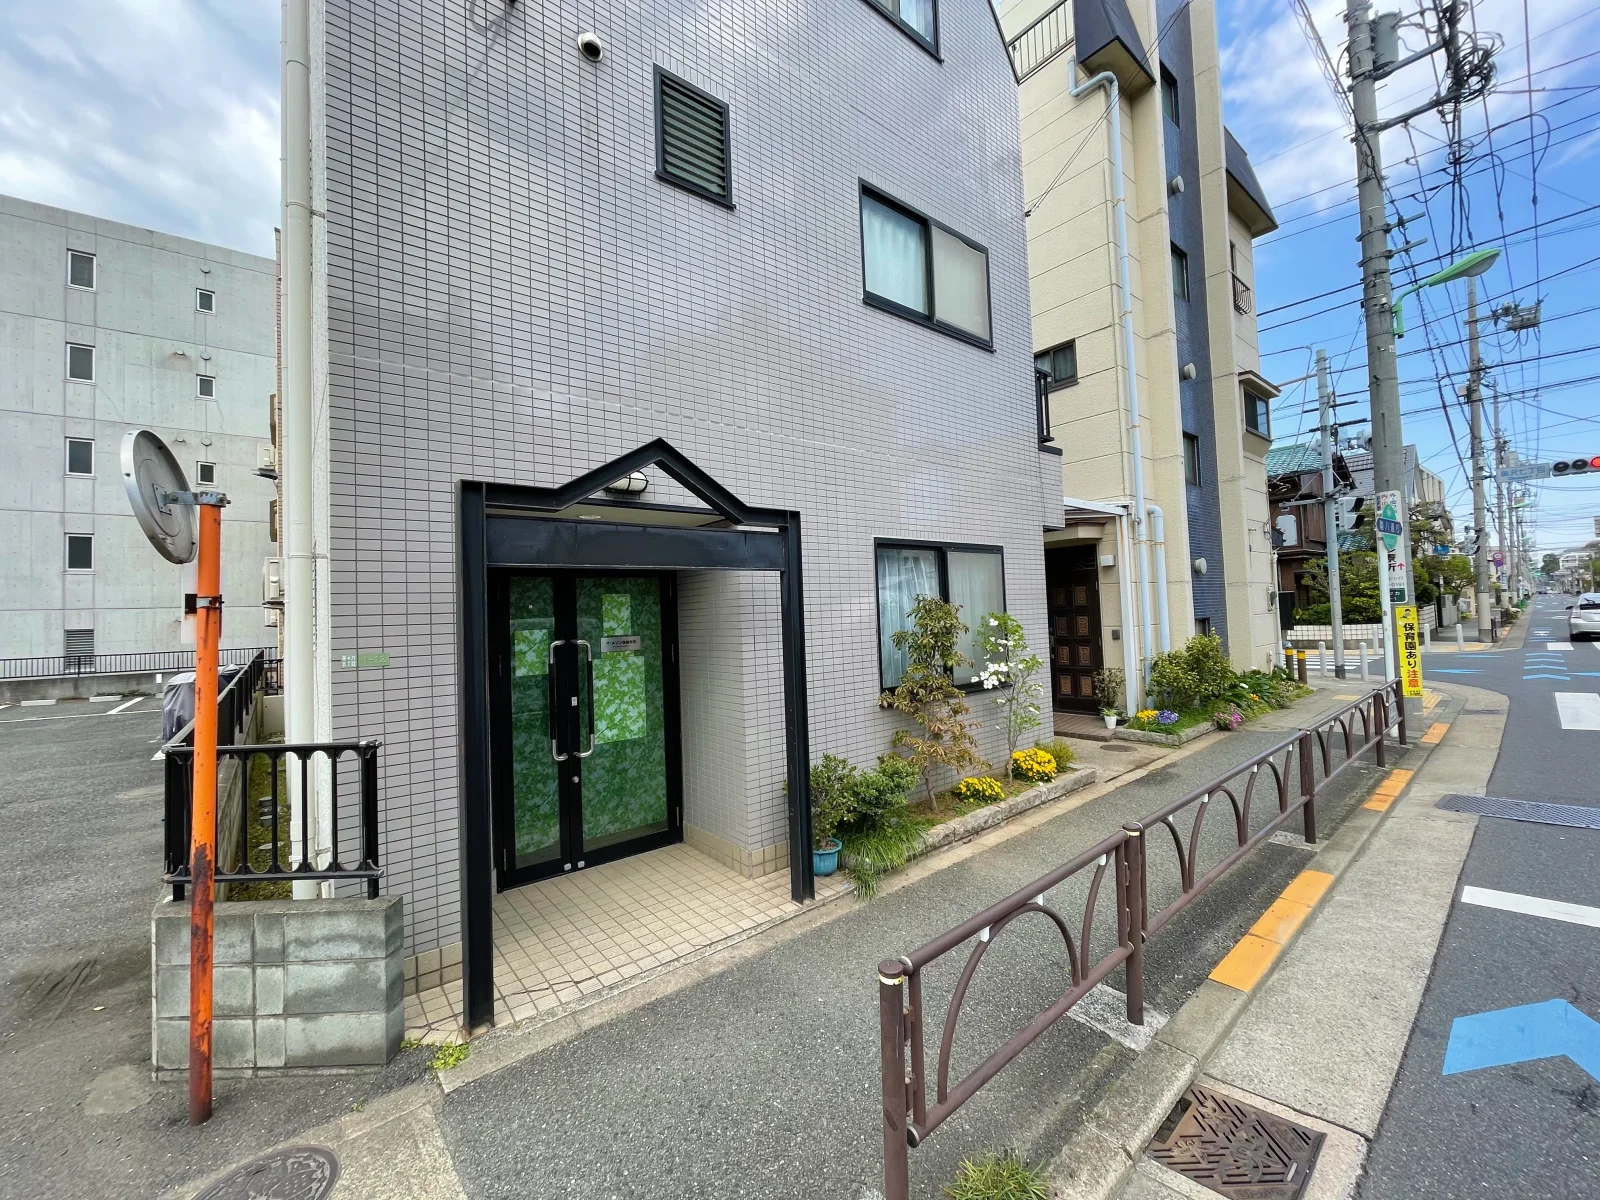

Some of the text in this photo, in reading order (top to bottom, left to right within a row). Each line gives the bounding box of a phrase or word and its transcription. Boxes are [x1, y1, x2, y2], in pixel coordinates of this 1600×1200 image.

[362, 655, 386, 664] 1-12
[1403, 622, 1419, 688] 保育園あり注意
